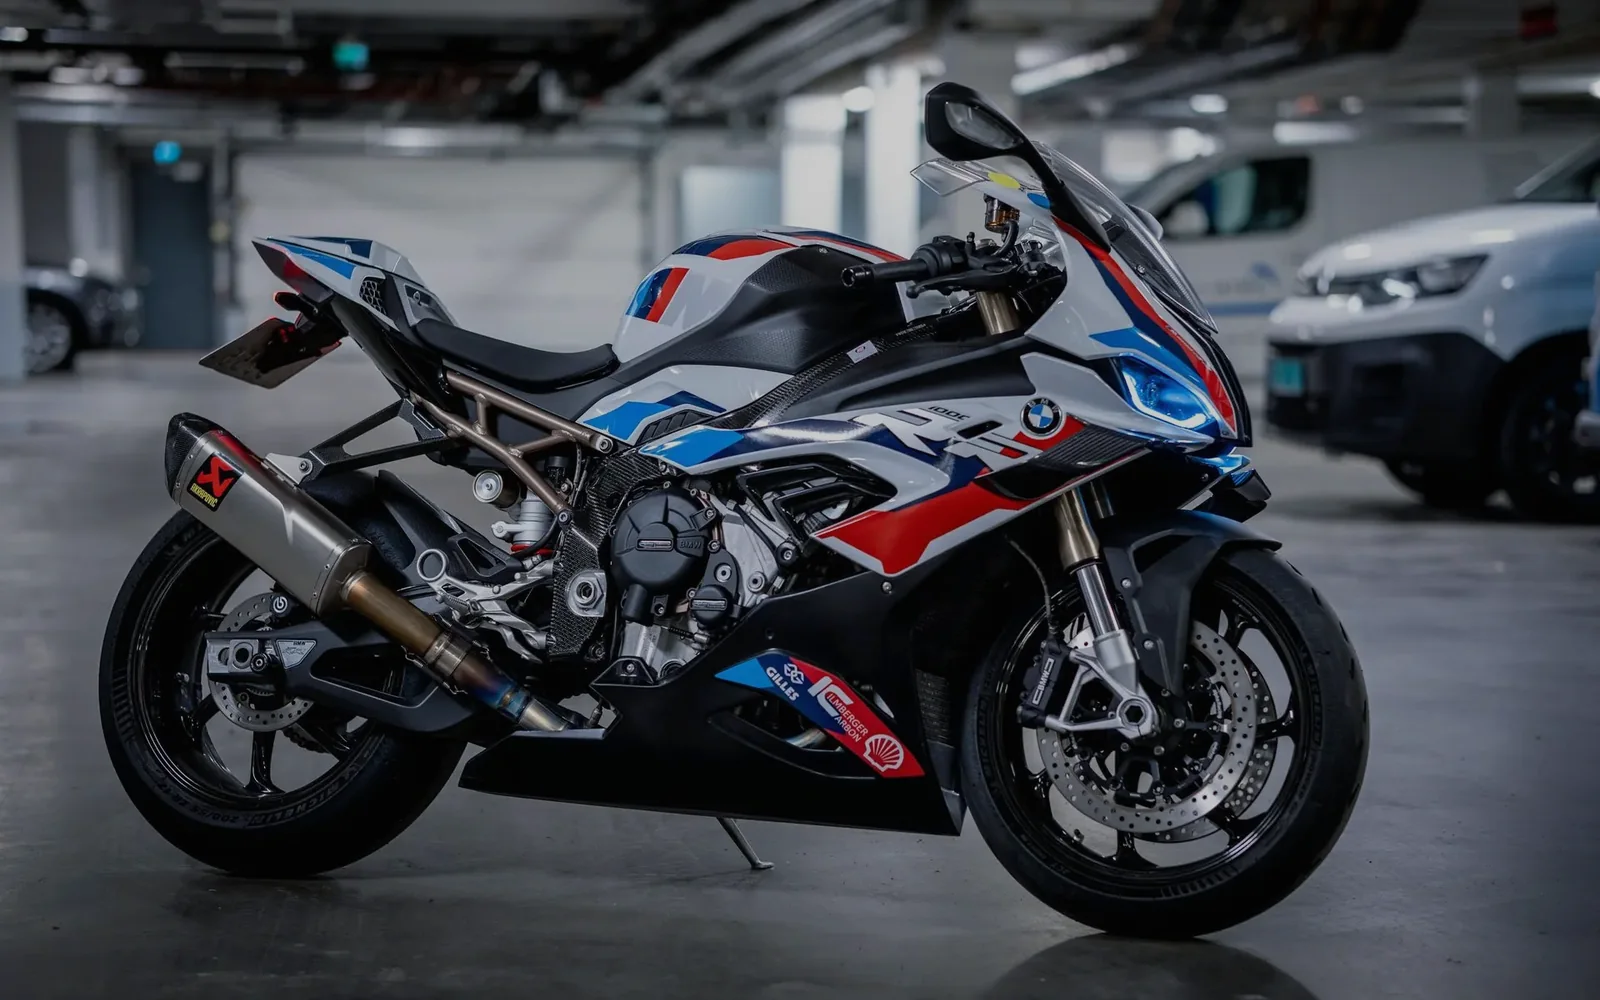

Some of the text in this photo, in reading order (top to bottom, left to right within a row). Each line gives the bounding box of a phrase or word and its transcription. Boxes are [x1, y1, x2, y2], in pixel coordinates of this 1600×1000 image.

[680, 541, 702, 549] BMW
[766, 666, 800, 701] GILLES
[1037, 669, 1050, 691] BMW
[826, 692, 869, 736] ILMBERGER
[834, 716, 862, 743] ARBON
[248, 781, 340, 826] MICHELIN
